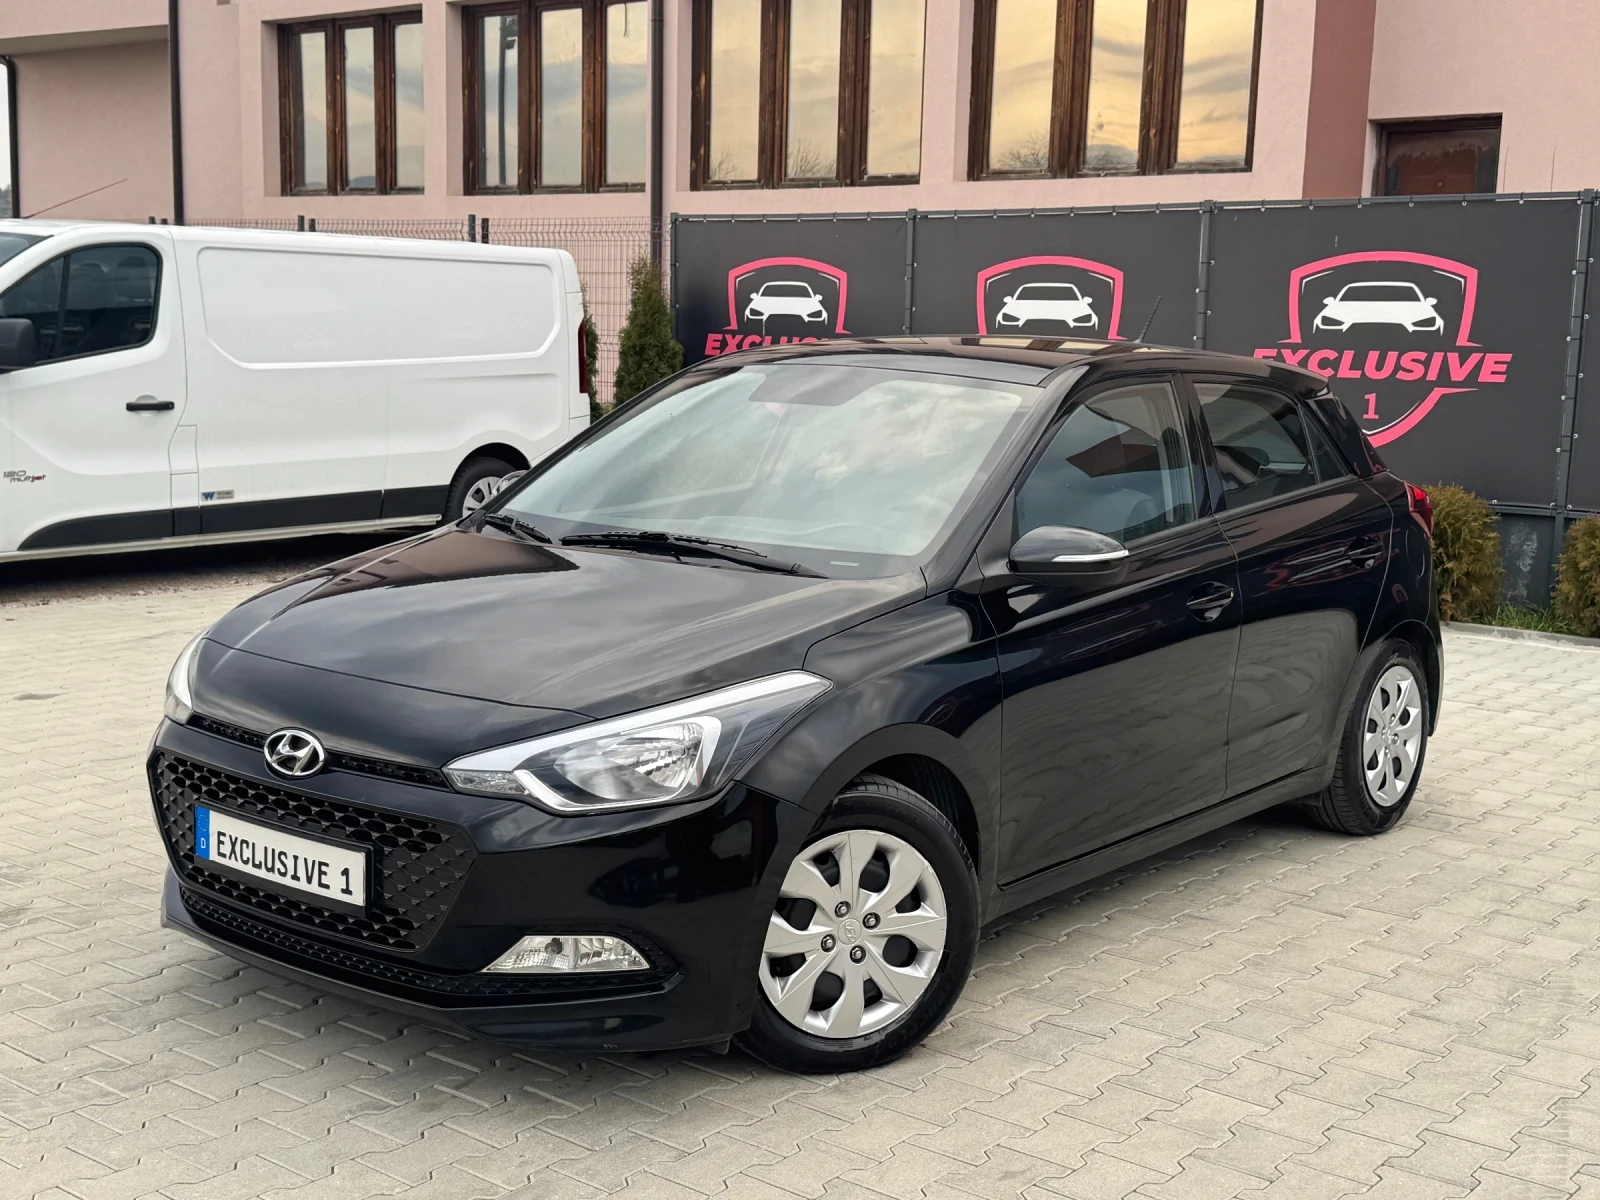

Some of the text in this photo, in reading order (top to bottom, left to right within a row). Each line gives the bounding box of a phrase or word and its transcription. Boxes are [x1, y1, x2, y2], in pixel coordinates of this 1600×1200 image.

[1363, 393, 1379, 419] 1
[200, 837, 207, 849] D
[217, 830, 353, 896] EXCLUSIVE 1
